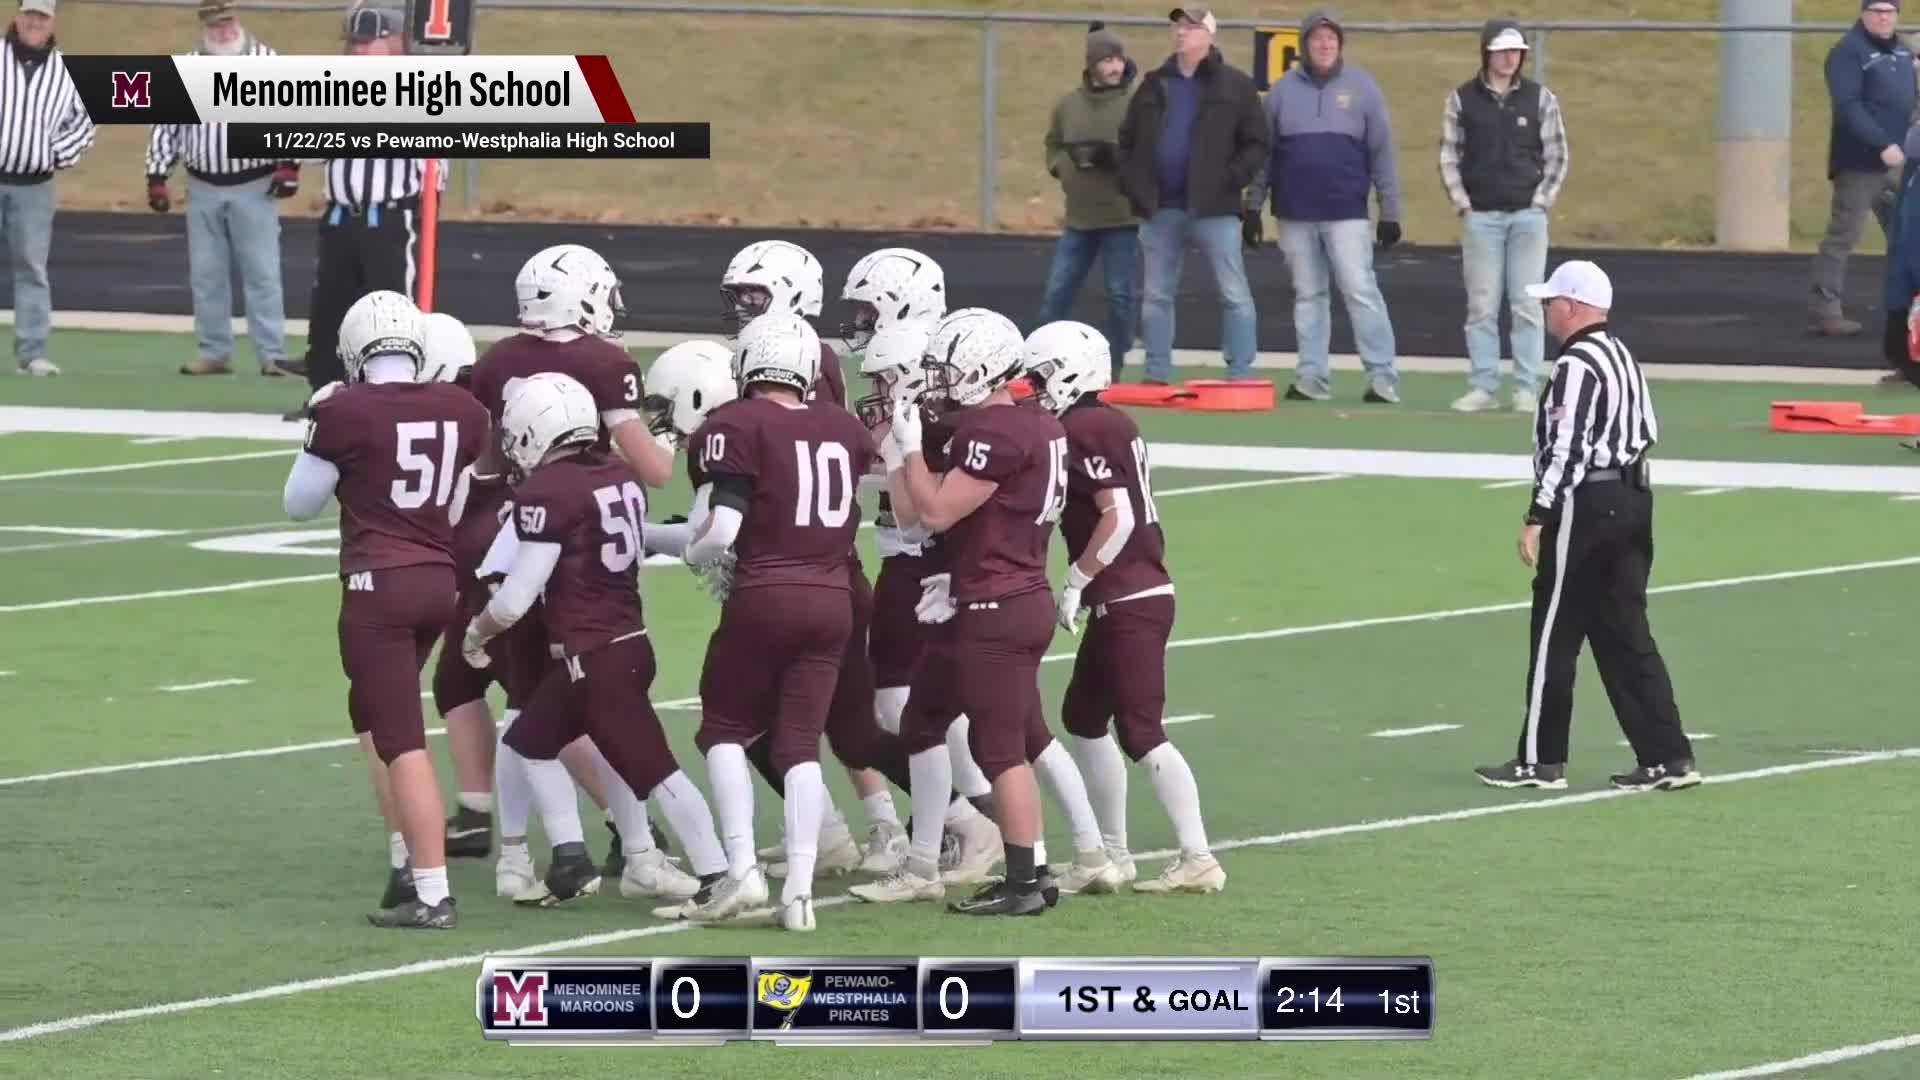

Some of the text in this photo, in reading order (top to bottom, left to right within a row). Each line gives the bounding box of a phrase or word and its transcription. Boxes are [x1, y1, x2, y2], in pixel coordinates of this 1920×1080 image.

[623, 374, 639, 402] 3
[705, 433, 726, 461] 10
[964, 439, 991, 471] 15
[389, 420, 459, 509] 51
[1083, 455, 1113, 480] 12
[794, 440, 853, 528] 10
[1034, 436, 1069, 526] 15
[519, 506, 547, 534] 50
[348, 570, 375, 592] M
